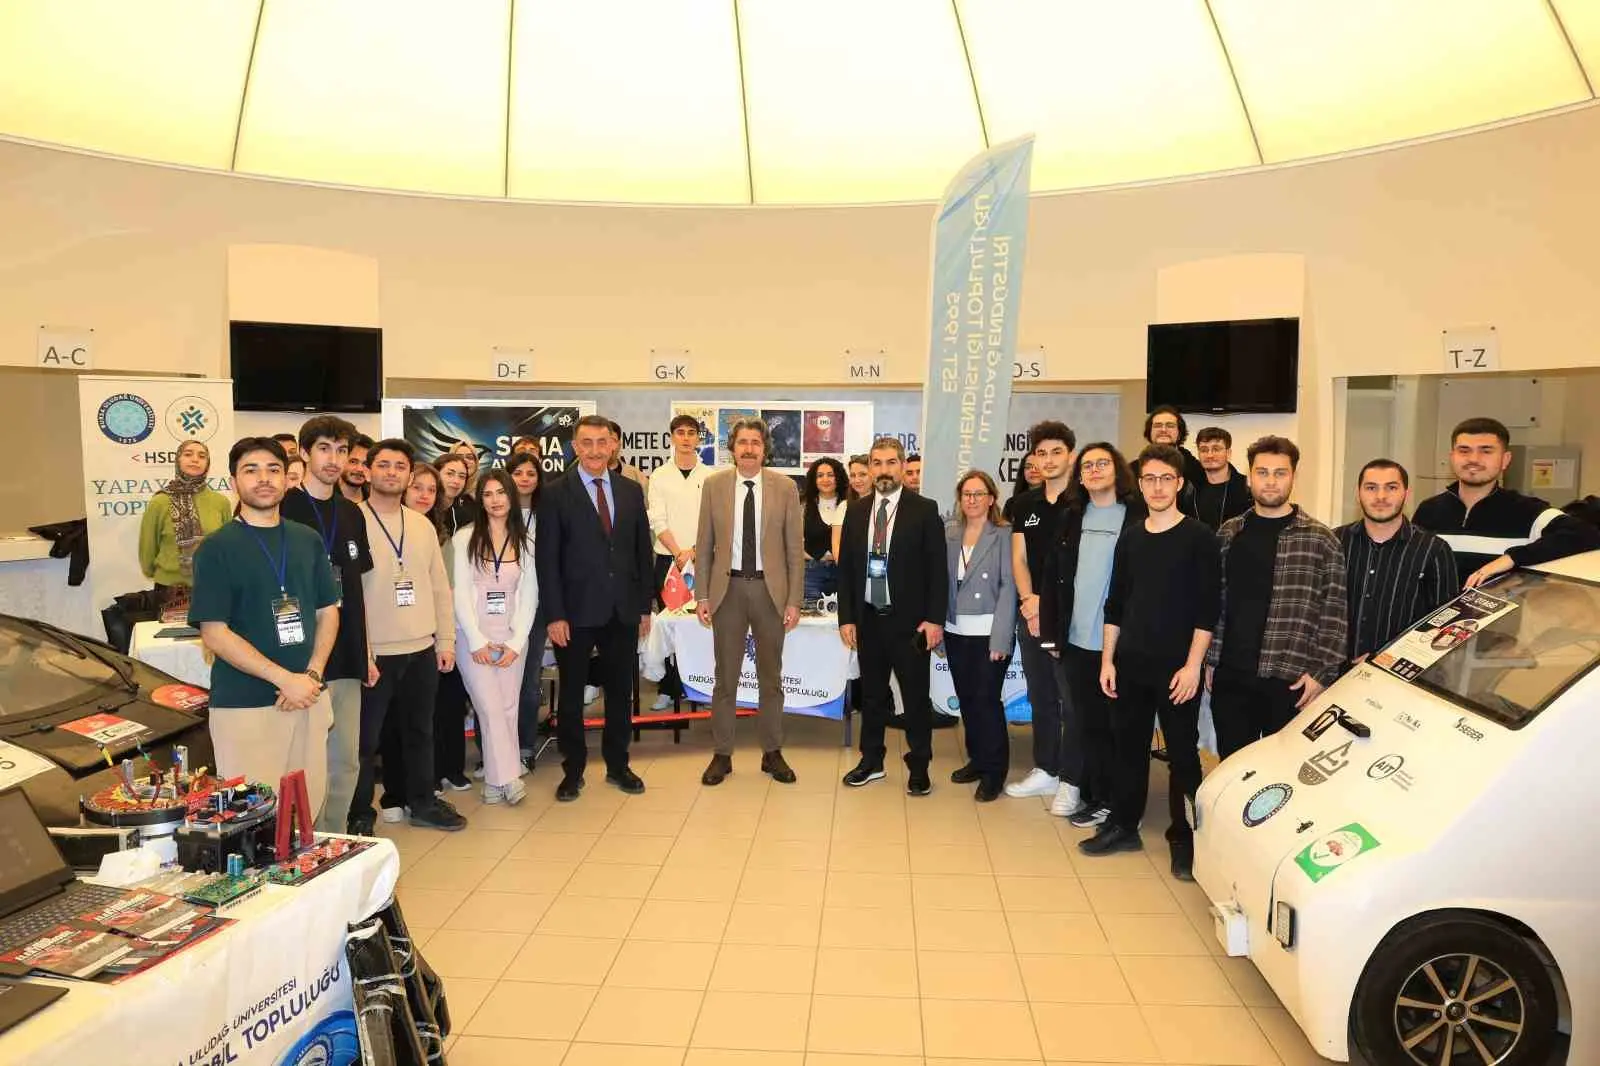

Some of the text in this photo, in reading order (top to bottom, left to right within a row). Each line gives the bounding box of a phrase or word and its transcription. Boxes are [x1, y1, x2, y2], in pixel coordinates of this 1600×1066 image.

[43, 346, 86, 366] A-C
[1449, 348, 1488, 369] T-Z
[496, 363, 528, 379] D-F
[654, 364, 687, 380] G-K
[850, 365, 881, 379] M-N
[622, 431, 659, 450] METE
[93, 478, 168, 495] YAPAY
[98, 501, 149, 517] TOP
[241, 961, 341, 1050] TOPLULUĞU
[188, 1023, 231, 1065] ULUDAĞ
